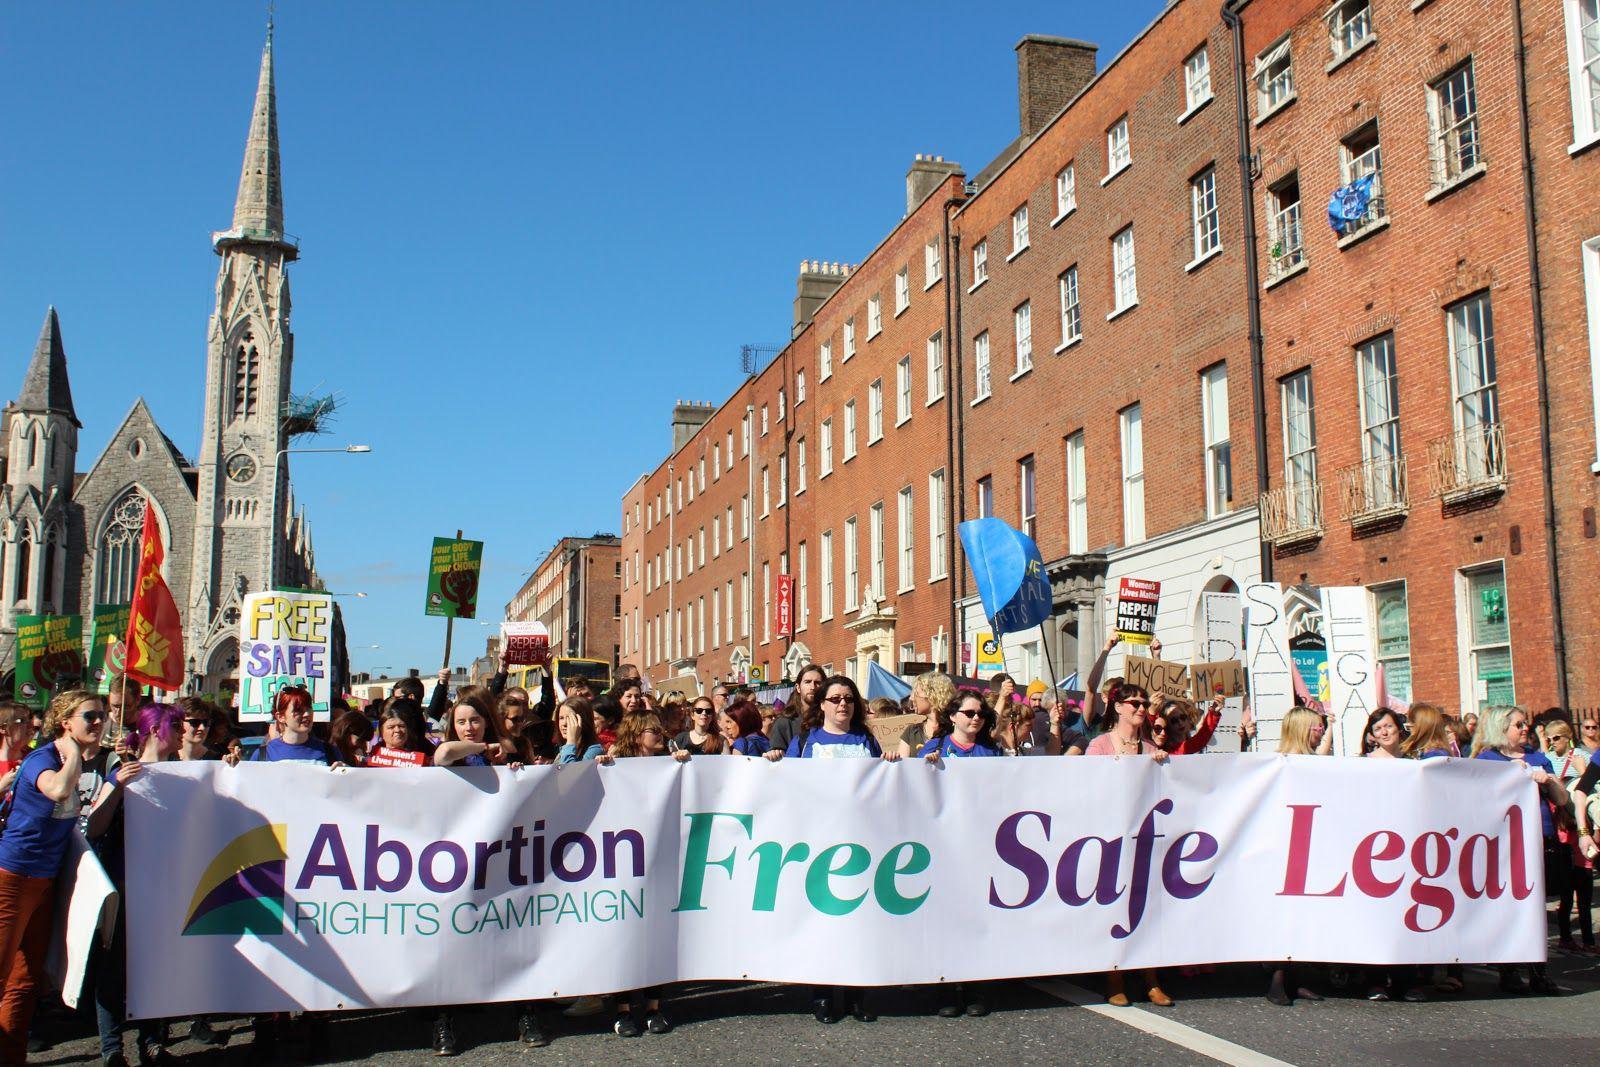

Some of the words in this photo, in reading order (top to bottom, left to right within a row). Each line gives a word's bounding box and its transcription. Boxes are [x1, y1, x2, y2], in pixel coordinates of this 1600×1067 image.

[433, 545, 451, 555] your
[452, 542, 474, 552] BODY
[433, 555, 451, 565] your
[453, 552, 468, 561] LIFE
[433, 564, 452, 575] your
[453, 560, 480, 572] CHOICE
[1128, 580, 1156, 590] Women's
[1121, 588, 1138, 597] Lives
[1139, 590, 1159, 600] Matter
[780, 581, 789, 634] AVENUE
[1119, 602, 1156, 617] REPEAL
[250, 596, 328, 643] FREE
[1118, 617, 1140, 631] THE
[18, 624, 42, 638] your
[44, 617, 71, 632] BODY
[20, 635, 44, 648] your
[46, 629, 66, 643] LIFE
[509, 636, 547, 649] REPEAL
[21, 646, 46, 660] your
[48, 638, 82, 655] CHOICE
[508, 650, 529, 661] THE
[247, 643, 325, 678] SAFE
[1292, 657, 1301, 666] To
[1303, 657, 1315, 666] Let
[1195, 668, 1216, 699] MY
[380, 747, 416, 760] Women's
[372, 756, 392, 766] Lives
[393, 759, 422, 768] Matter
[294, 819, 646, 894] Abortion
[671, 812, 931, 916] Free
[988, 798, 1219, 939] Safe
[1275, 804, 1535, 932] Legal
[294, 900, 440, 936] RIGHTS
[451, 887, 645, 935] CAMPAIGN
